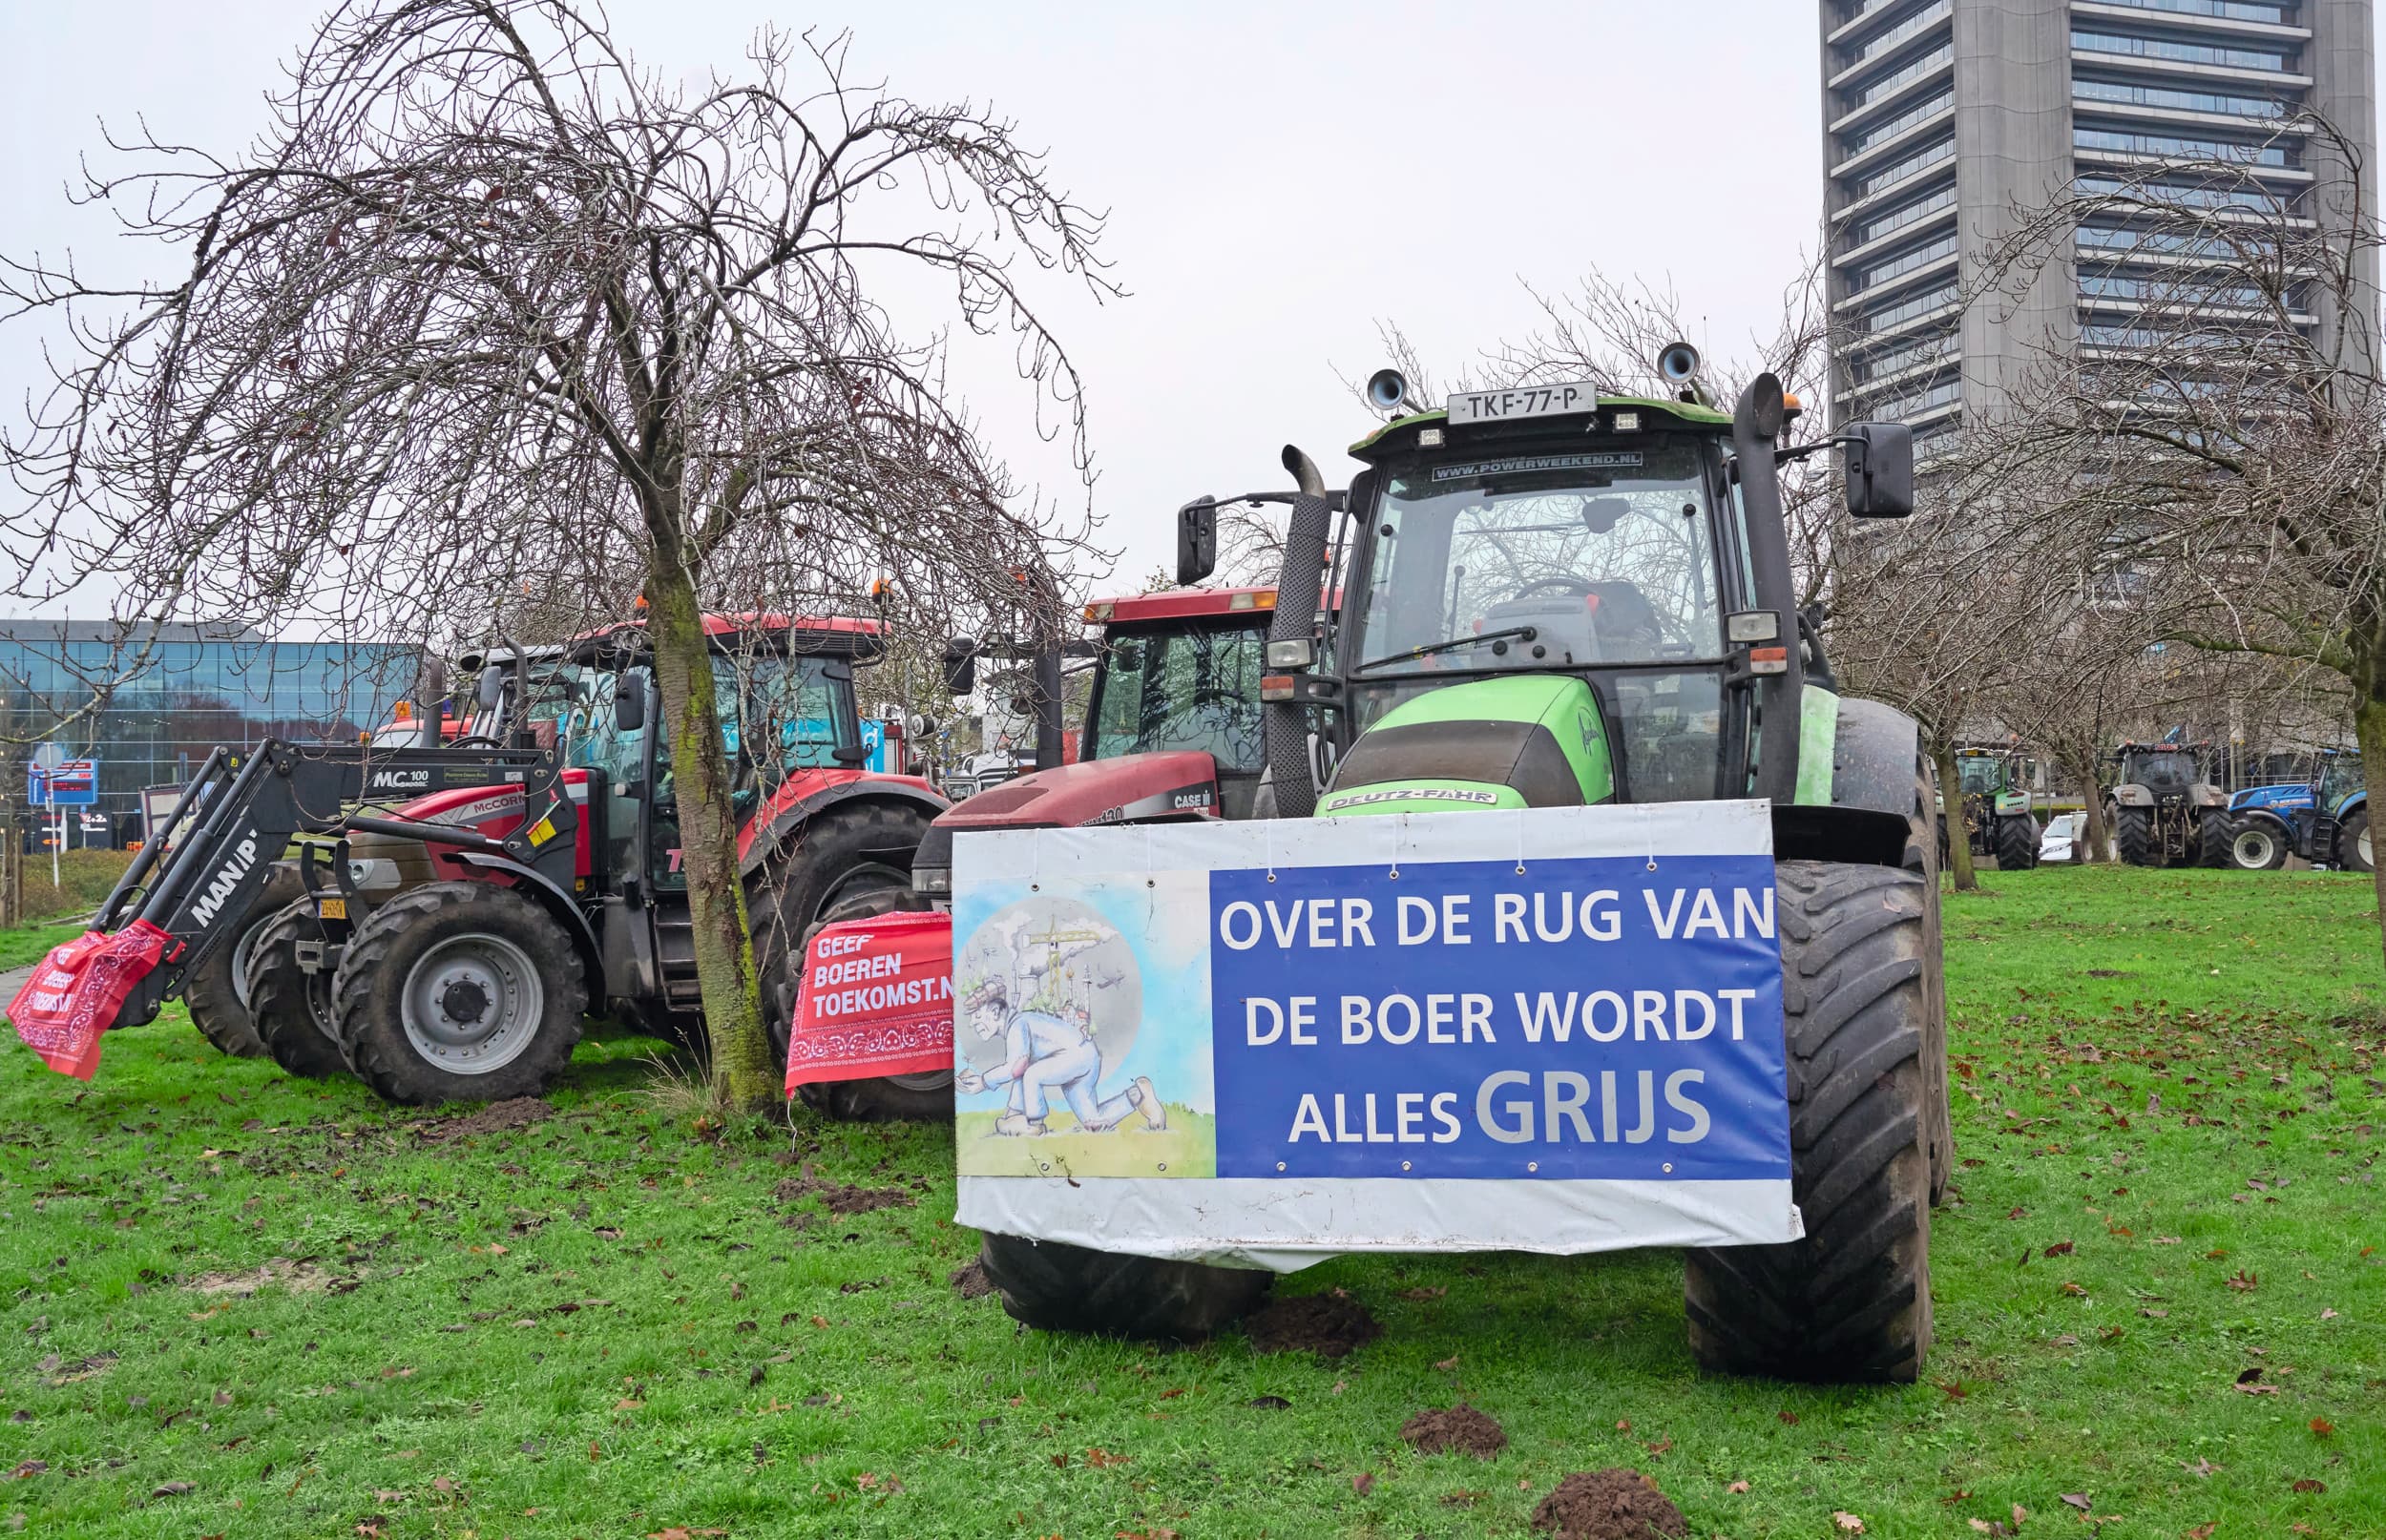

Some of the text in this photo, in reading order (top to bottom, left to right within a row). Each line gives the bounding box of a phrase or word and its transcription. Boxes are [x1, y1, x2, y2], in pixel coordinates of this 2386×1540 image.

[1468, 387, 1578, 418] TKF-77-P
[1435, 454, 1641, 479] WWW.POWERWEEKEND.NL
[373, 771, 407, 787] MC
[410, 770, 429, 781] 100
[1175, 794, 1201, 809] CASE
[1330, 789, 1491, 808] DEUTZ-FAHR
[1220, 887, 1774, 950] OVER DE RUG VAN
[817, 934, 874, 959] GEEF
[814, 952, 902, 989] BOEREN
[1245, 989, 1756, 1046] DE BOER WORDT
[1287, 1068, 1712, 1144] ALLES GRIJS
